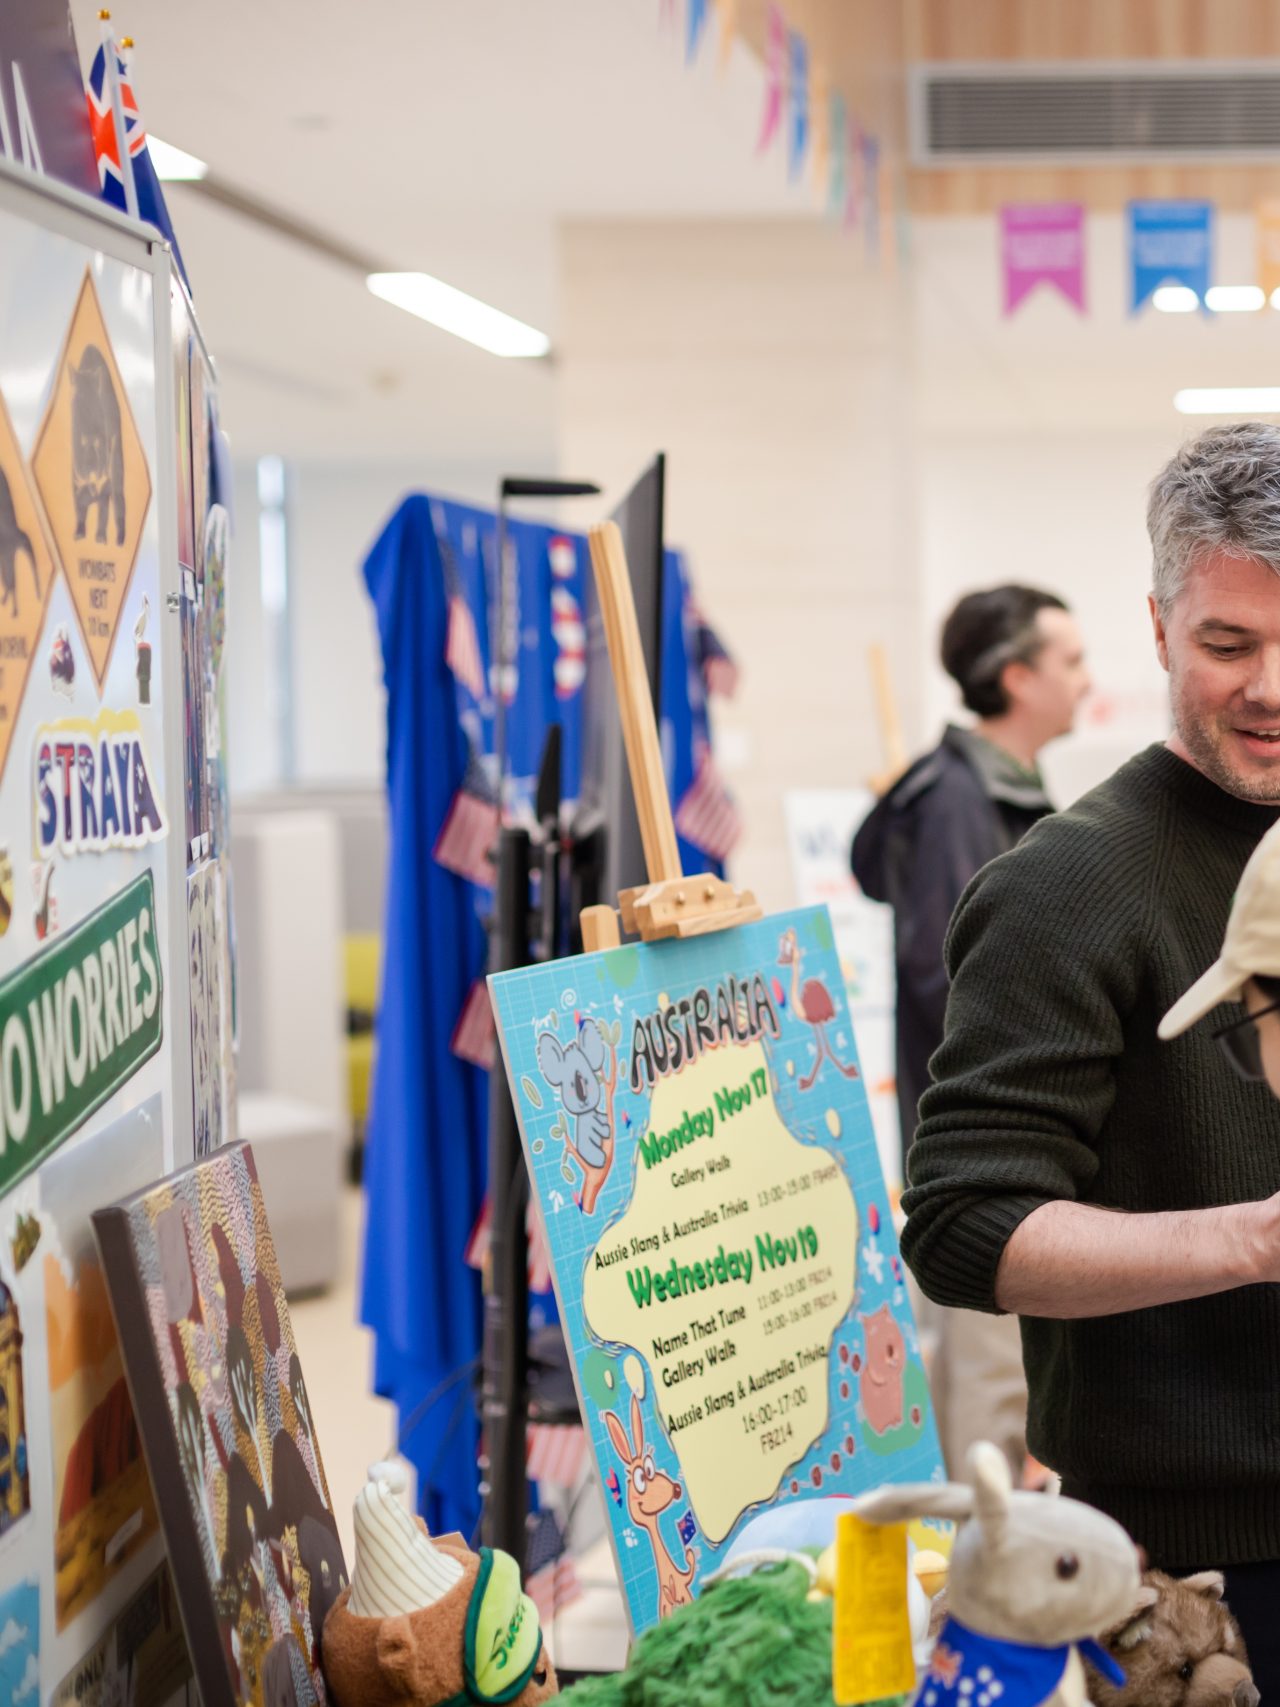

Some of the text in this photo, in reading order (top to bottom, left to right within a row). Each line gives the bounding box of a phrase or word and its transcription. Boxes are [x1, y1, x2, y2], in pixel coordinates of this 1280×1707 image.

[79, 559, 116, 582] WOMBATS
[90, 588, 108, 609] NEXT
[39, 740, 163, 847] STRAYA
[0, 907, 158, 1157] O WORRIES
[630, 974, 779, 1090] AUSTRALIA
[638, 1067, 768, 1169] Monday Nov 17
[671, 1155, 731, 1189] Gallery Walk
[595, 1244, 629, 1270] Aussie
[630, 1233, 660, 1255] Slang
[662, 1226, 671, 1243] &
[673, 1209, 719, 1239] Australia
[720, 1198, 749, 1219] Trivia
[626, 1224, 819, 1309] Wednesday Nov 19
[652, 1331, 689, 1359] Name
[689, 1315, 718, 1342] That
[718, 1305, 746, 1329] Tune
[662, 1356, 704, 1388] Gallery
[705, 1338, 736, 1367] Walk
[668, 1342, 828, 1434] Aussie Slang & Australia Trivia
[742, 1385, 808, 1434] 16:00-17:00
[760, 1421, 794, 1454] FB214
